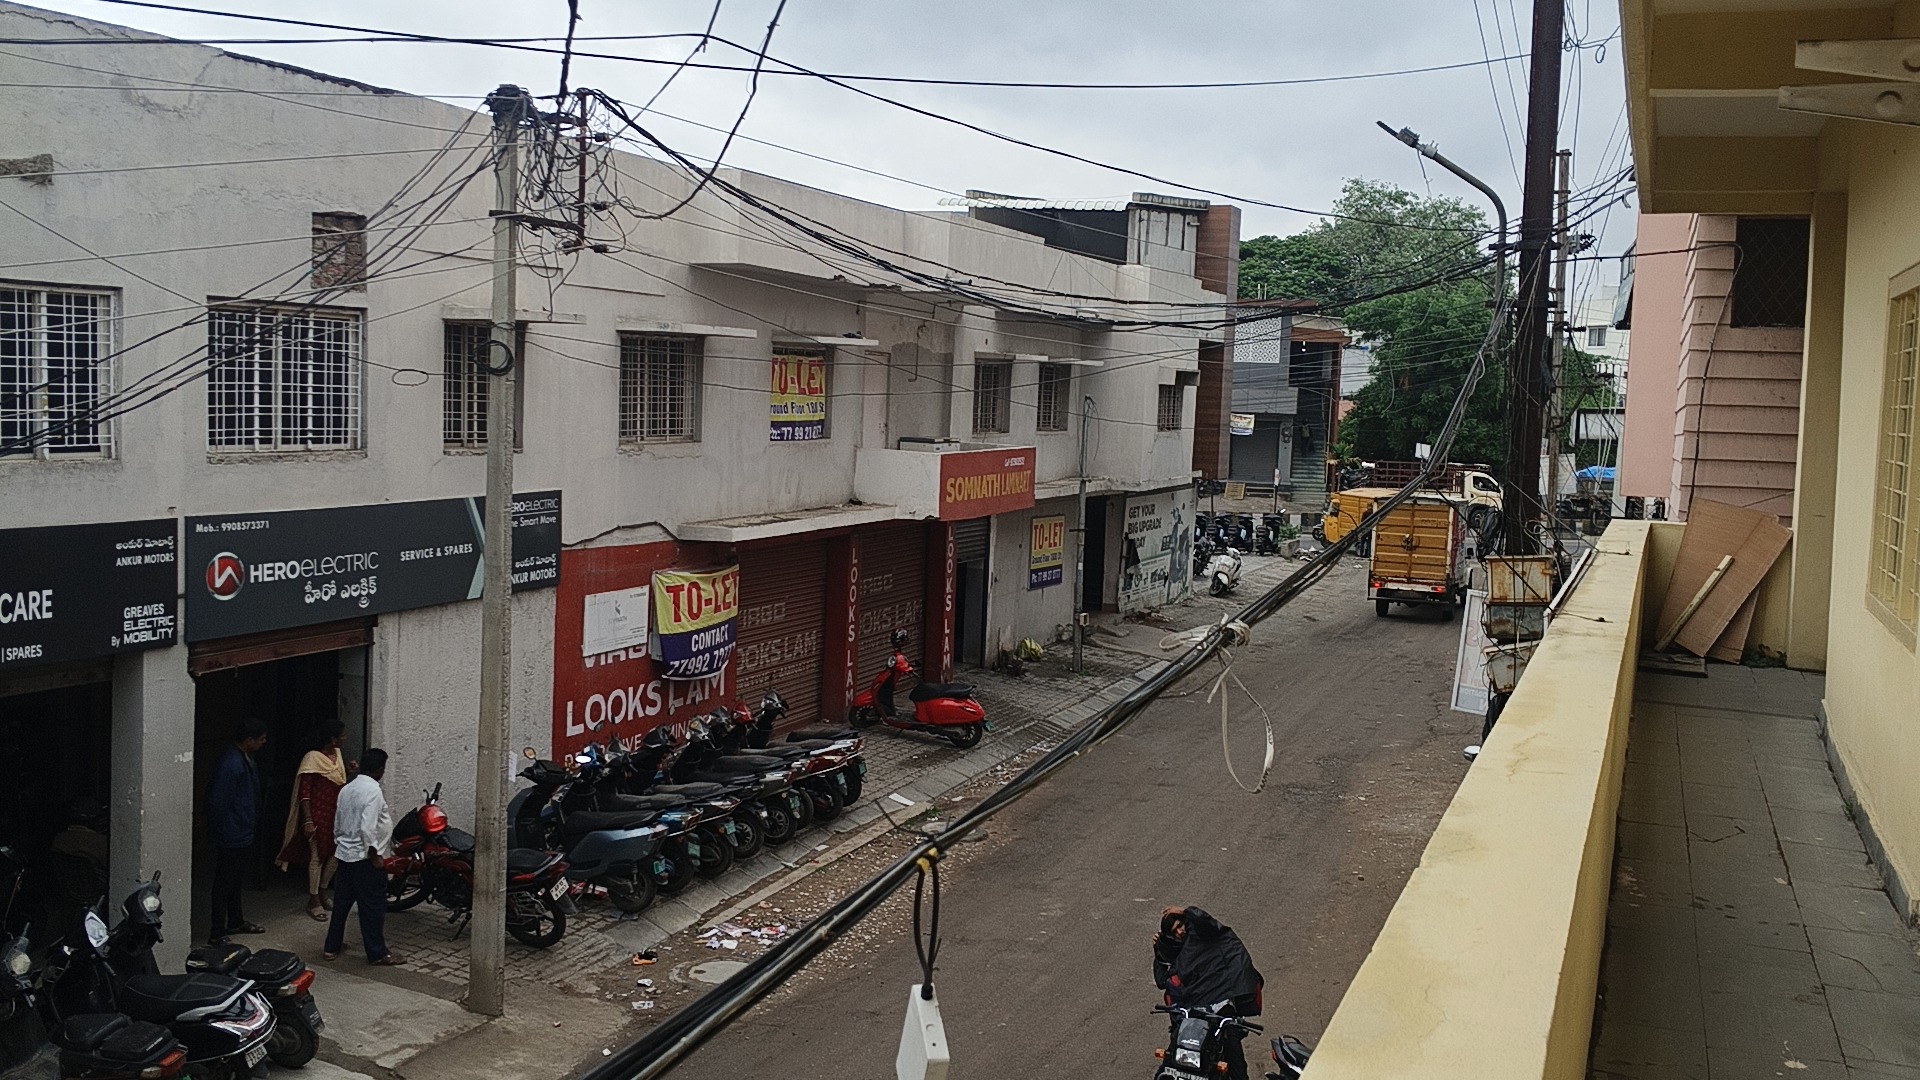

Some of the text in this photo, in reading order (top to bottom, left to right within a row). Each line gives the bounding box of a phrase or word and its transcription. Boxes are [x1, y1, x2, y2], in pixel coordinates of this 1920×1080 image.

[946, 473, 1001, 503] SOMNATH
[520, 516, 539, 527] Smart
[540, 515, 556, 525] Move
[1128, 506, 1140, 519] GET
[220, 519, 270, 532] 9908573371
[1033, 522, 1064, 551] TO-LET
[115, 552, 175, 567] ANKUR MOTORS
[400, 543, 473, 562] SERVICE & SPARES
[510, 568, 557, 585] NKUR MOTORS
[945, 525, 955, 612] LOOKS
[665, 570, 739, 624] TO-LET
[848, 547, 859, 643] LOOKS
[0, 588, 53, 624] CARE
[123, 603, 165, 619] GREAVES
[123, 615, 175, 632] ELECTRIC
[111, 627, 174, 648] By MOBILITY
[691, 624, 729, 652] CONTACT
[6, 644, 43, 661] SPARES
[666, 652, 711, 676] 77992
[565, 680, 663, 738] LOOKS
